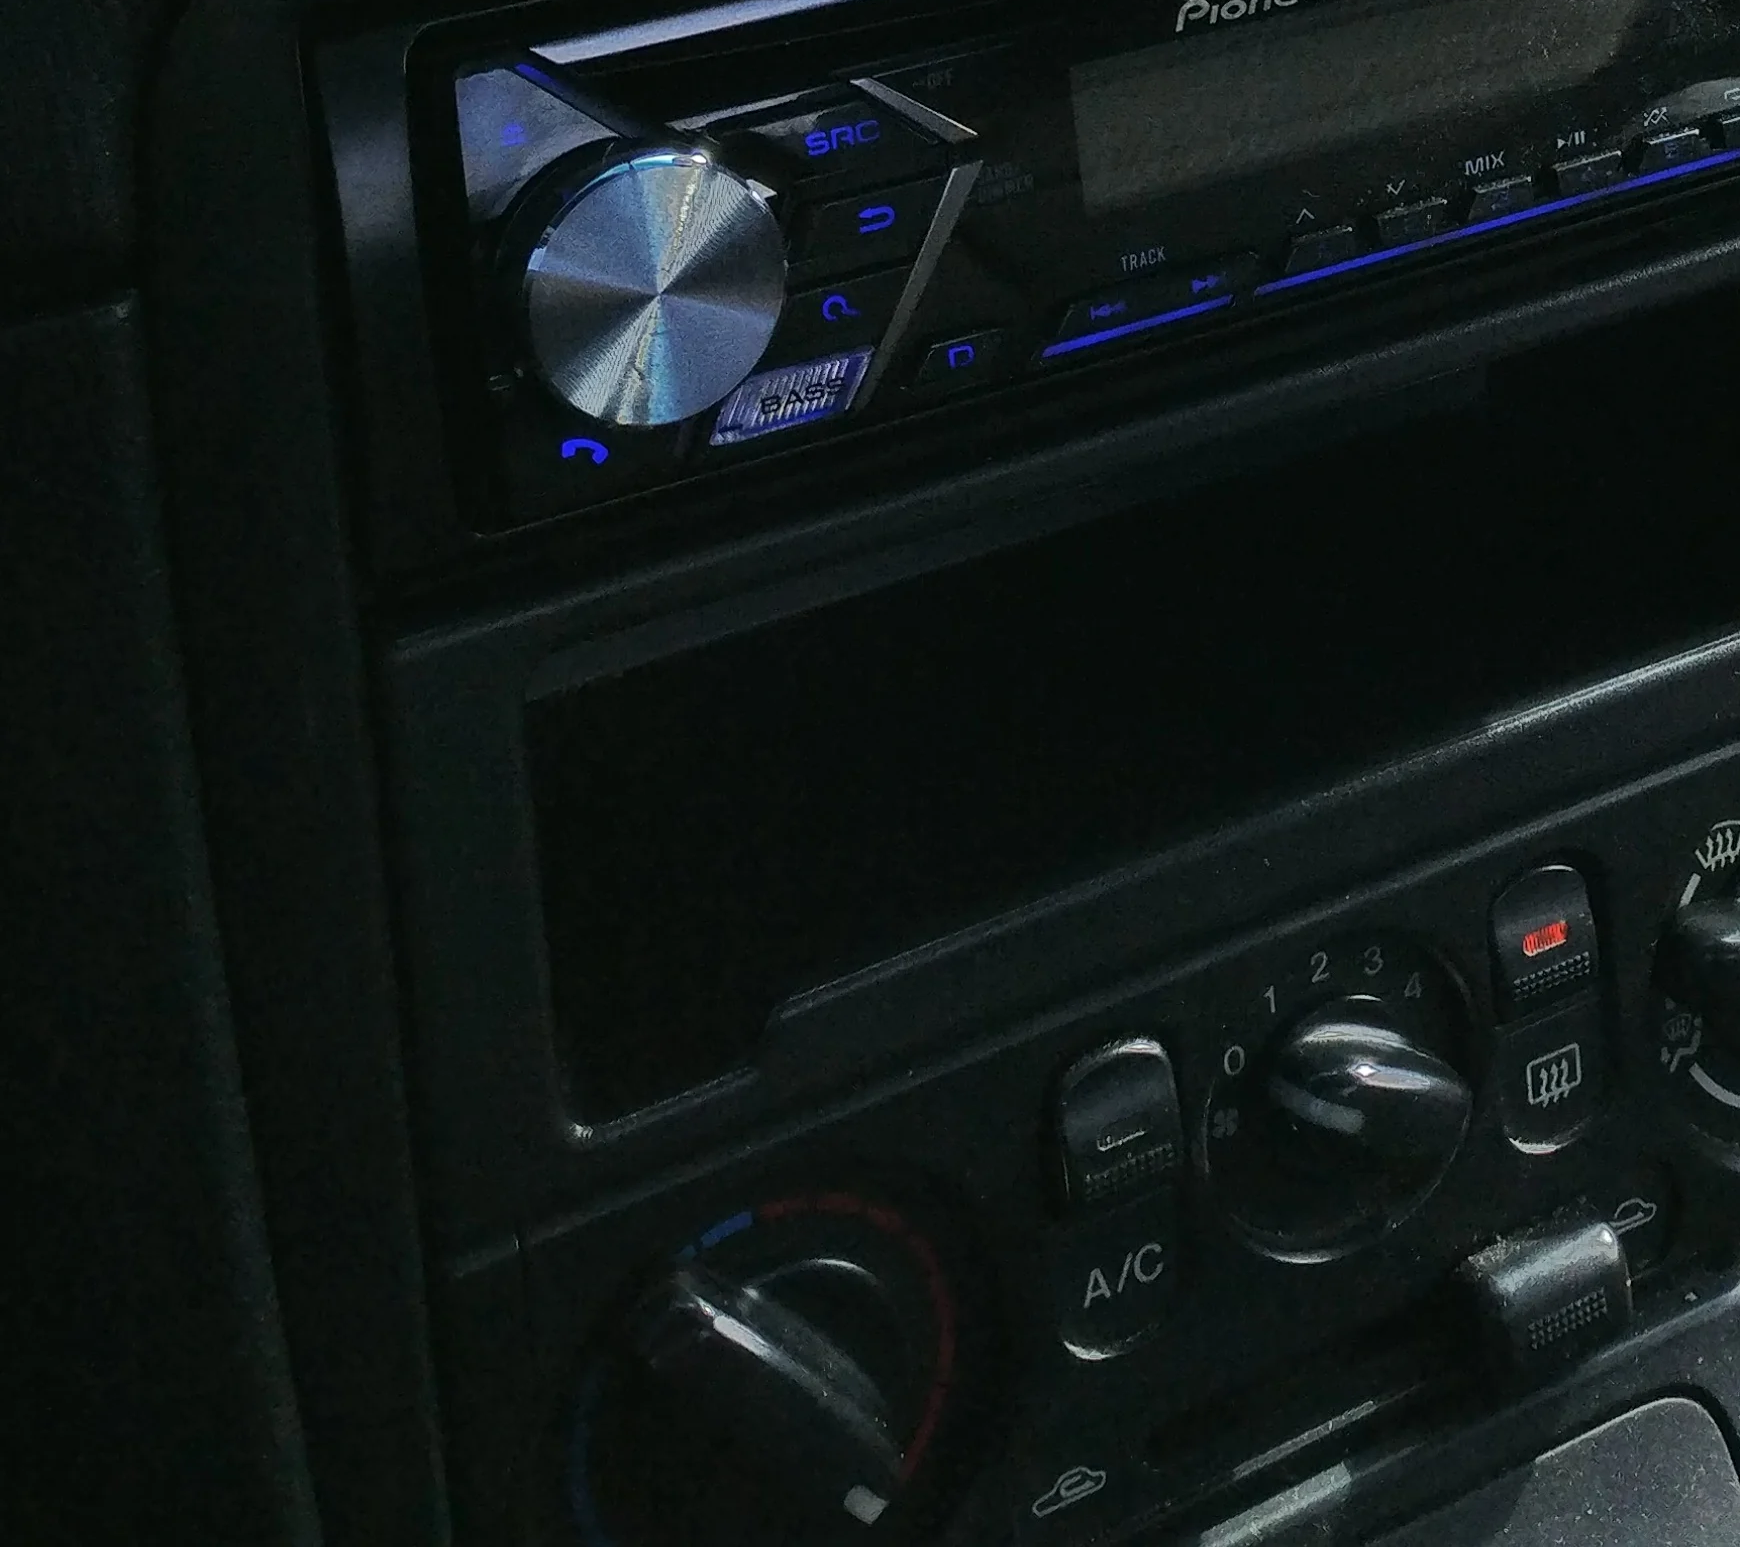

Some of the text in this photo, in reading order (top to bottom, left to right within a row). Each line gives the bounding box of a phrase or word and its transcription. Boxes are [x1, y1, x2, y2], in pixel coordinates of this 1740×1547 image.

[805, 119, 881, 156] SRC
[1464, 149, 1506, 177] MIX
[1120, 245, 1167, 273] TRACK
[760, 377, 845, 415] BASS
[1309, 950, 1331, 984] 2
[1363, 946, 1385, 977] 3
[1262, 984, 1277, 1014] 1
[1403, 970, 1422, 999] 4
[1223, 1045, 1246, 1076] 0
[1084, 1242, 1164, 1309] A/C
